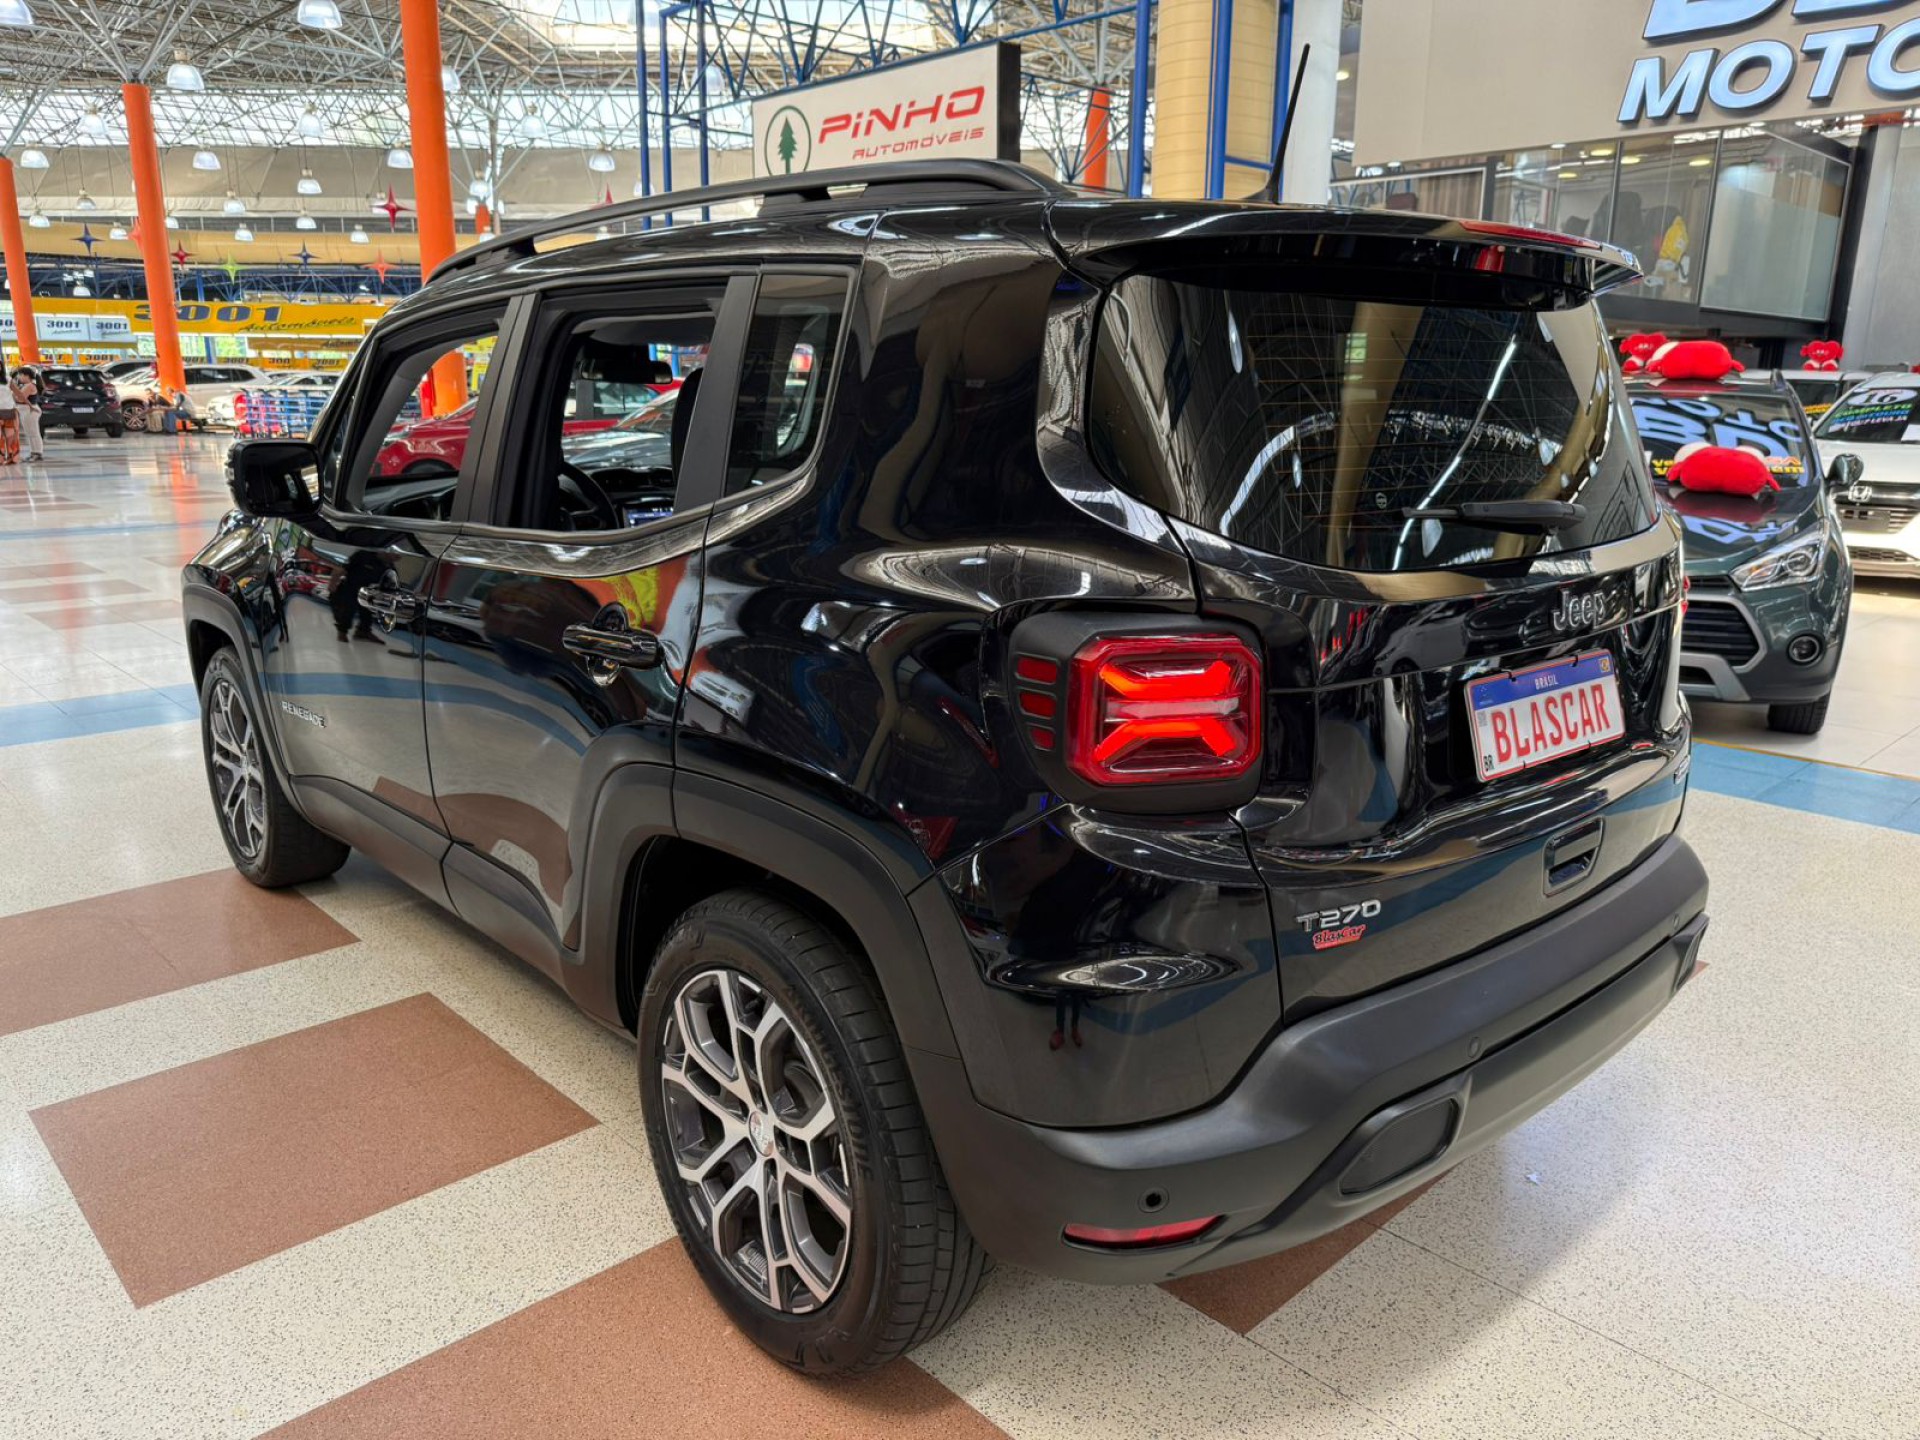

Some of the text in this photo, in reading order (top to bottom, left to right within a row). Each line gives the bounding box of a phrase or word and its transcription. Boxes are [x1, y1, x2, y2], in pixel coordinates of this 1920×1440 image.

[1616, 17, 1920, 122] MOTO
[46, 320, 80, 329] 3001
[96, 322, 128, 330] 3001
[1553, 590, 1606, 631] Jeep
[1534, 674, 1559, 691] BRASIL
[1491, 683, 1611, 764] BLASCAR
[1483, 754, 1495, 772] BR
[1296, 899, 1382, 933] T270
